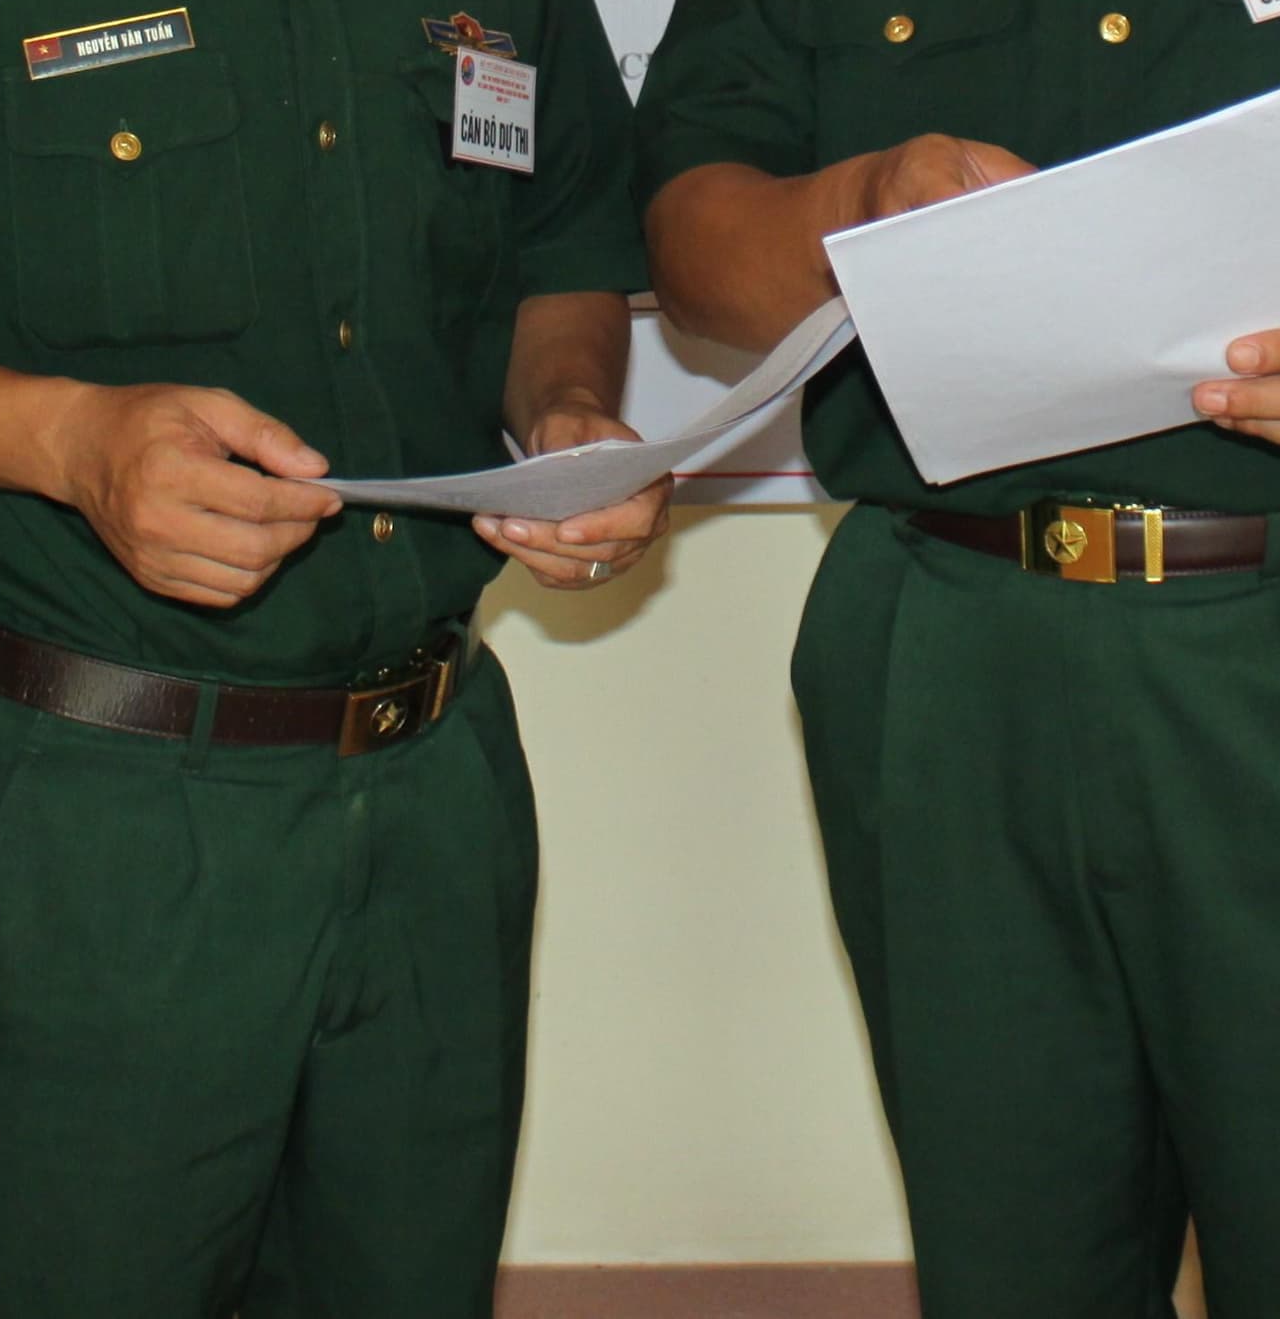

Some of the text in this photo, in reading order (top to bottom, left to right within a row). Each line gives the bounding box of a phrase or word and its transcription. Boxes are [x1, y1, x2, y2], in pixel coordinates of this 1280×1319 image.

[460, 110, 529, 158] CÁN BỘ DỰ THI
